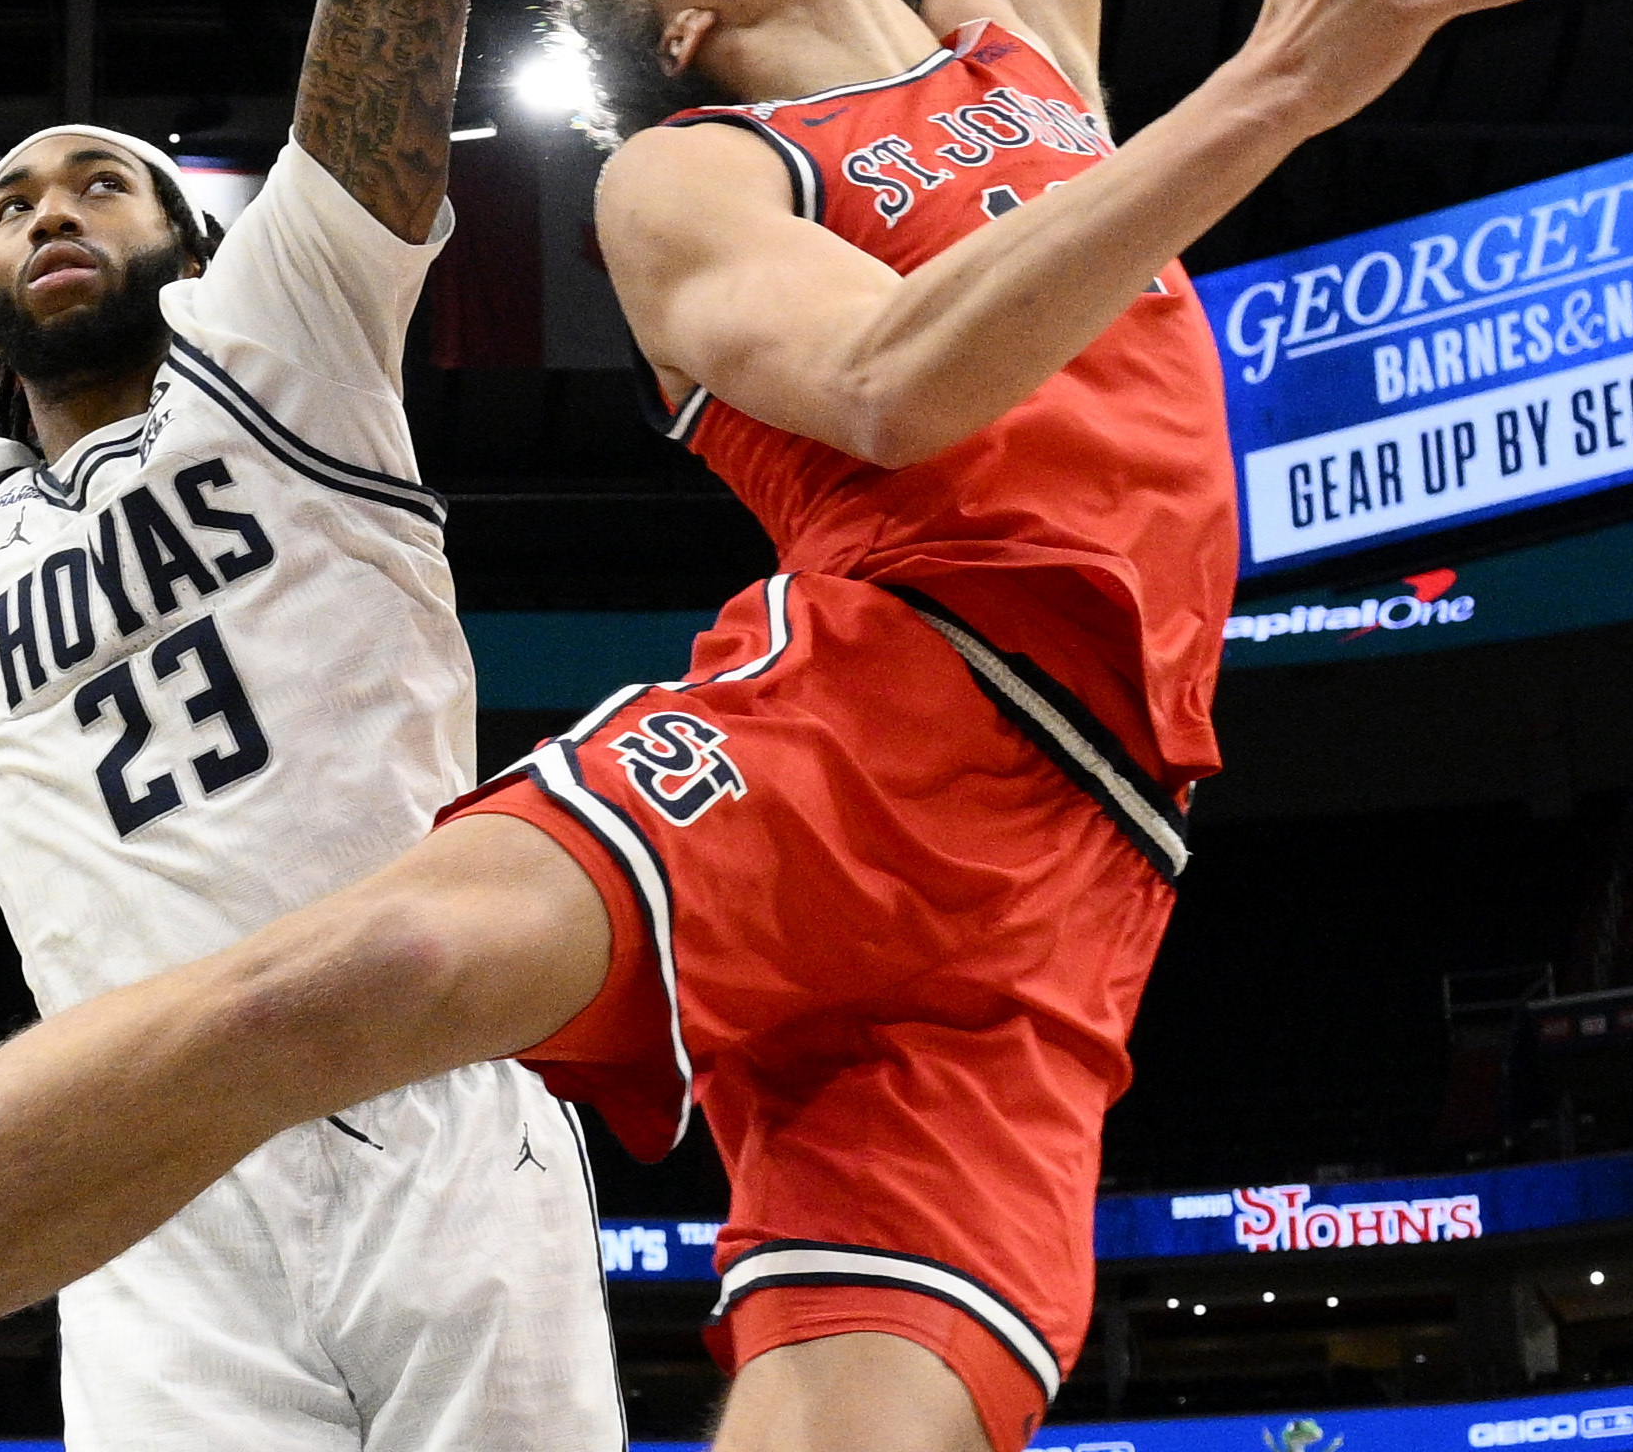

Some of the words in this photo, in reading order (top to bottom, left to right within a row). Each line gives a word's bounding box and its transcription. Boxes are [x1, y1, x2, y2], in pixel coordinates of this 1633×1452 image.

[1288, 442, 1402, 529] GEAR
[1422, 422, 1476, 494] UP
[1498, 403, 1551, 477] BY
[1222, 595, 1476, 642] apitalOne
[73, 613, 274, 844] 23
[1467, 1413, 1577, 1449] GEICO
